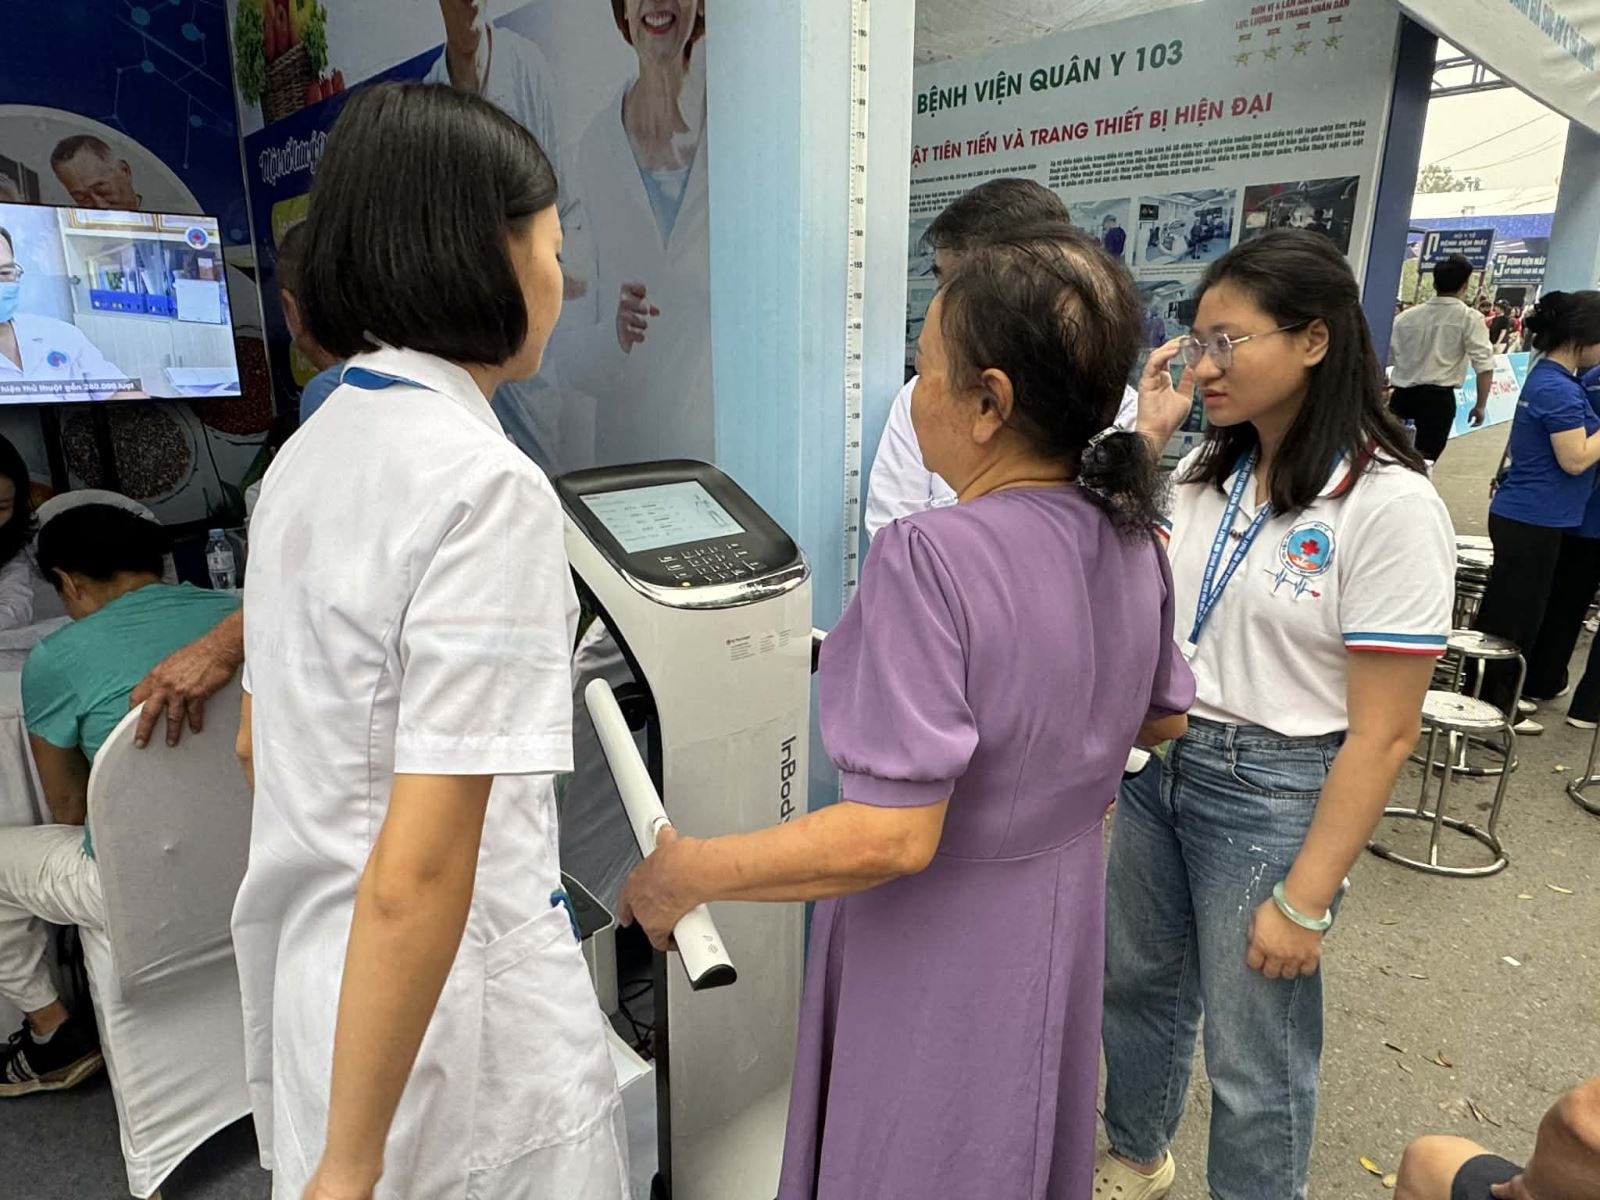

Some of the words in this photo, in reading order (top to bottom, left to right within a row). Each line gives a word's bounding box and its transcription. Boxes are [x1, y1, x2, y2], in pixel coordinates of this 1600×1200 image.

[917, 85, 967, 118] BỆNH
[974, 70, 1022, 105] VIỆN
[1029, 54, 1102, 92] QUÂN
[1110, 51, 1126, 77] Y
[1135, 39, 1184, 72] 103
[932, 140, 962, 162] TIÊN
[966, 130, 997, 158] TIẾN
[1003, 127, 1025, 151] VÀ
[1030, 121, 1089, 146] TRANG
[1095, 106, 1144, 138] THIẾT
[1149, 109, 1169, 132] BỊ
[1174, 97, 1224, 127] HIỆN
[1231, 92, 1273, 119] ĐẠI
